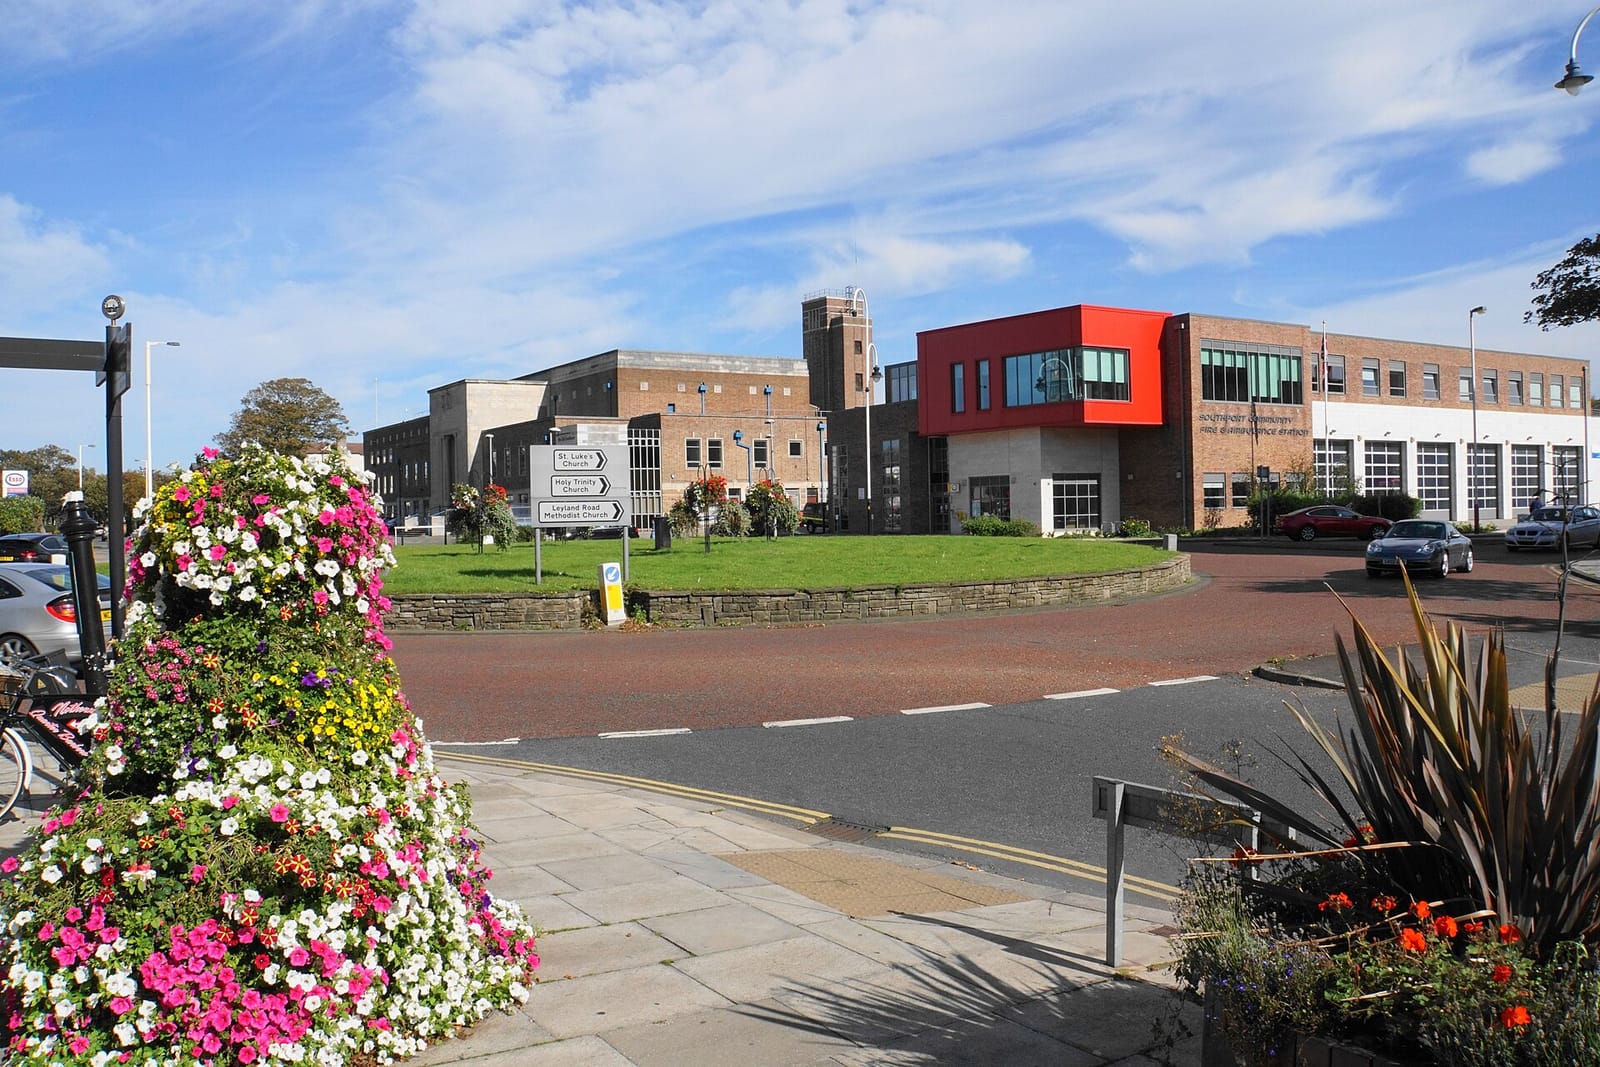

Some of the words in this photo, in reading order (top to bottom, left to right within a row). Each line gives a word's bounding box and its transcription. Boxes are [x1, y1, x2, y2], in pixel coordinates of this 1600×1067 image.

[1199, 414, 1246, 422] SOUTHPORT
[1200, 426, 1217, 434] FIRE
[1278, 427, 1309, 436] STATION
[574, 478, 596, 486] Trinity
[552, 504, 580, 512] Leyland
